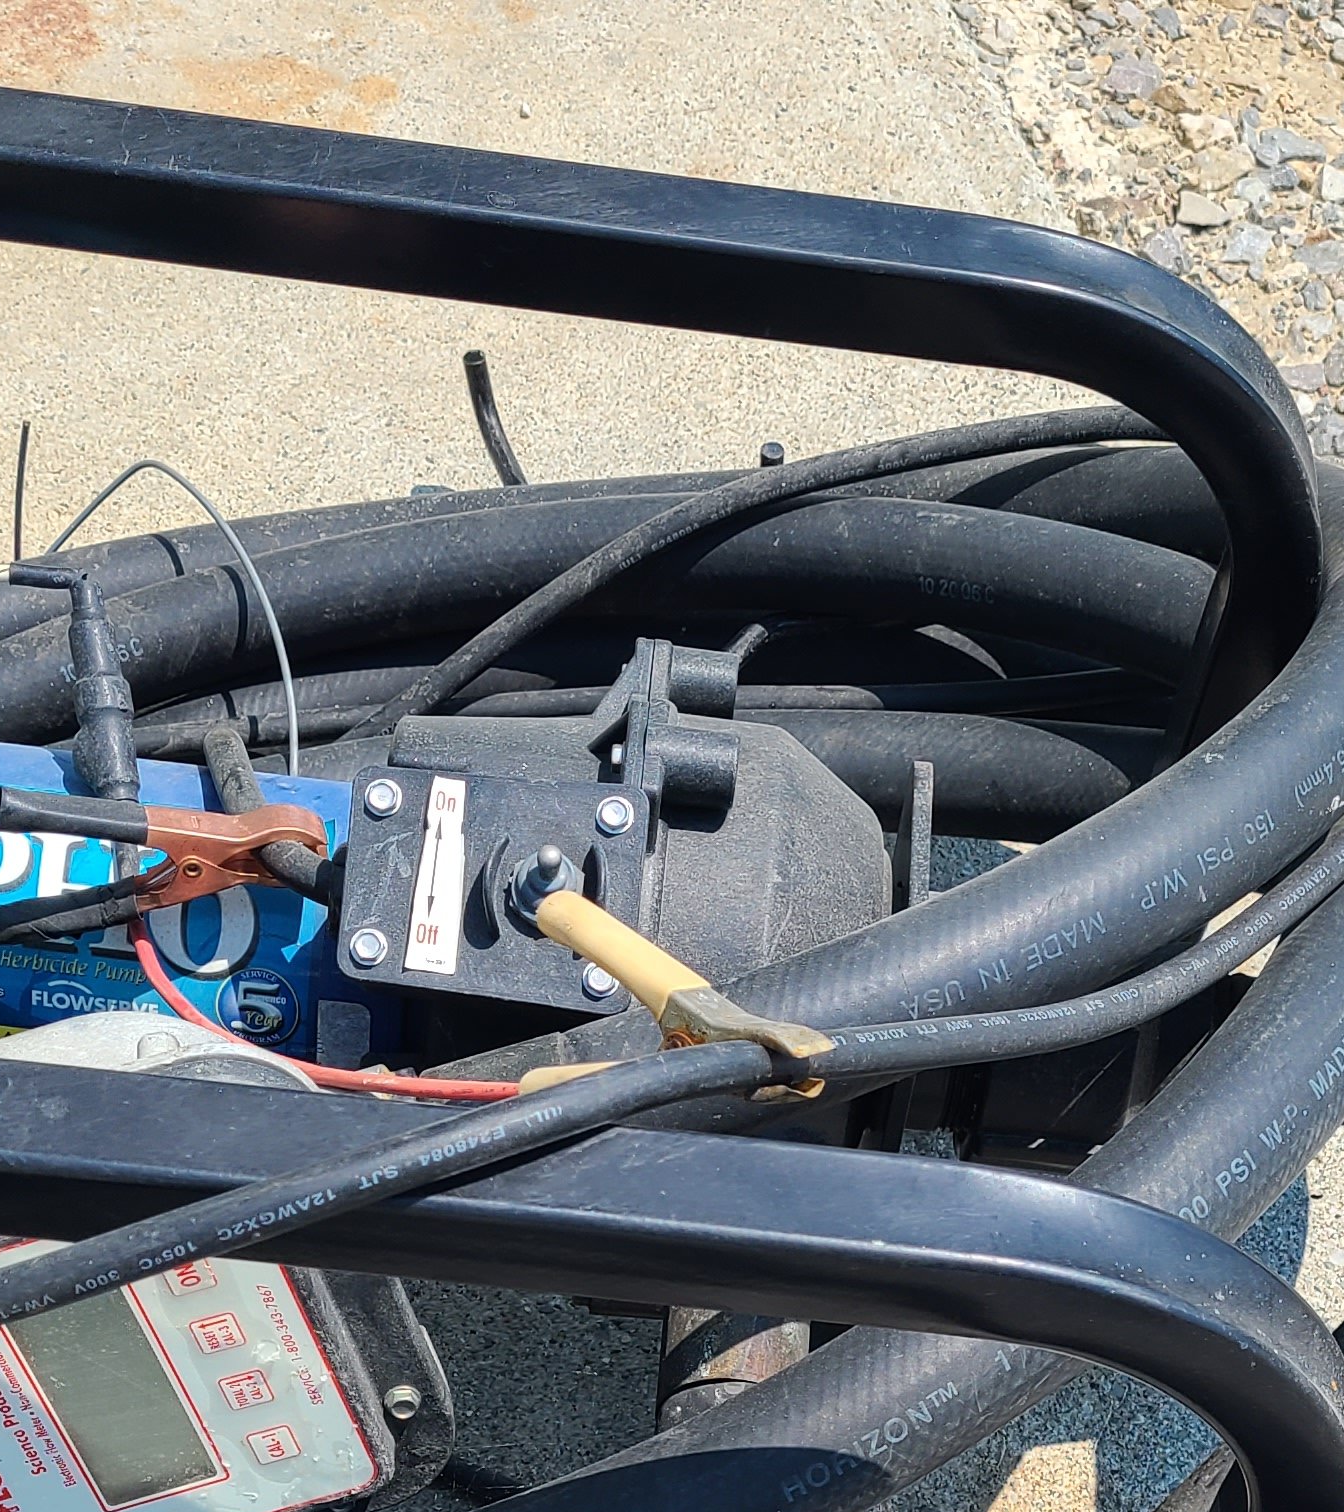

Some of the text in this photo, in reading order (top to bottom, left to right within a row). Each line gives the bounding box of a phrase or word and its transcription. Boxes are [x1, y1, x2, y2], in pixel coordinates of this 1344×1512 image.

[436, 790, 457, 813] On
[1196, 836, 1235, 876] PSI
[416, 922, 440, 946] Off
[1024, 910, 1108, 972] MADE
[0, 949, 88, 977] Herbicide
[94, 964, 147, 985] Pump
[240, 969, 277, 983] SERVICE
[977, 958, 1012, 991] IN
[230, 980, 284, 1033] 5 Year
[899, 979, 966, 1021] USA
[357, 1164, 400, 1191] SJT
[1215, 1149, 1257, 1197] PSI
[217, 1187, 337, 1241] 12AWGX2C
[74, 1268, 121, 1295] 300V
[202, 1330, 221, 1350] RESET
[254, 1284, 304, 1362] 1-800-343-7867
[12, 1429, 47, 1476] Scienco
[260, 1432, 286, 1459] CAL-1
